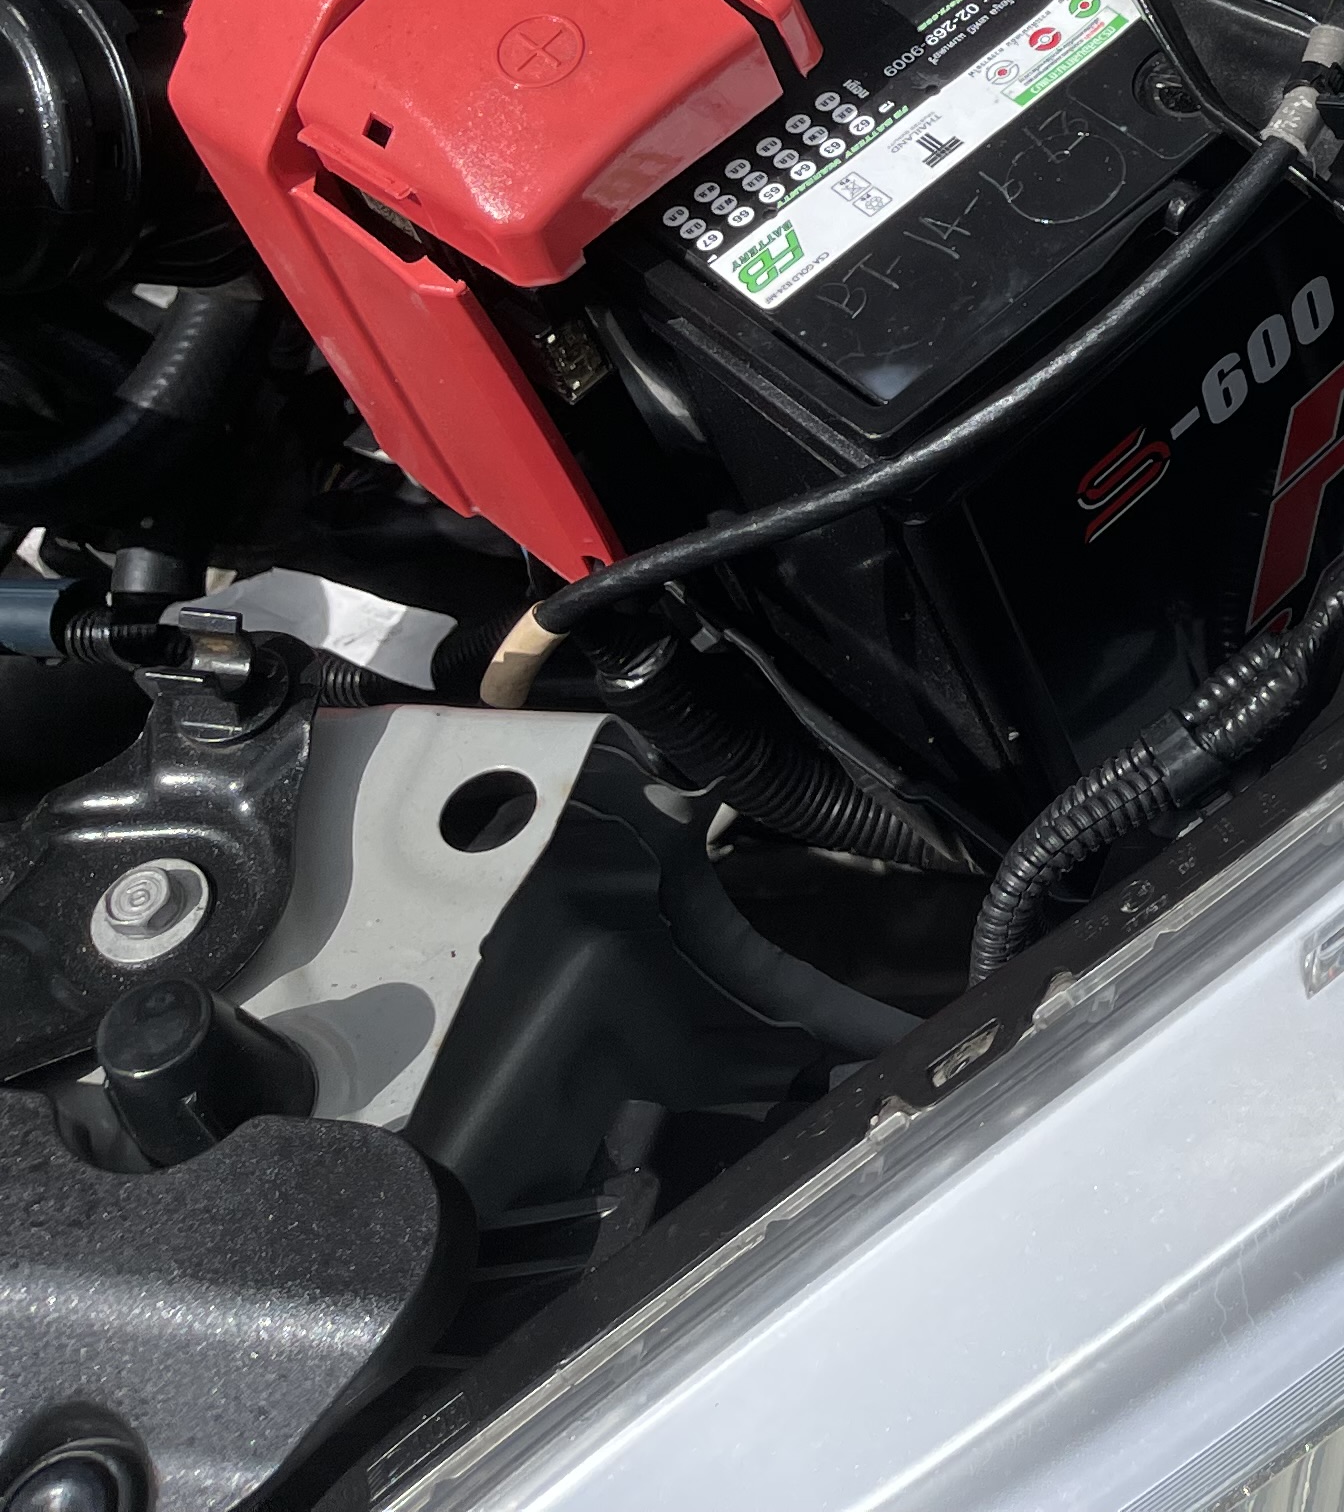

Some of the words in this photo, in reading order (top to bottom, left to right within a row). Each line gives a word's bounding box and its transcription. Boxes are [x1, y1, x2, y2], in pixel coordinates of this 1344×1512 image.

[881, 1, 981, 78] 02-269-9009
[854, 119, 870, 132] 62
[890, 110, 943, 154] THAILAND
[844, 116, 893, 157] BATTERY
[824, 142, 841, 154] 63
[794, 164, 811, 177] 64
[763, 186, 780, 199] 65
[777, 158, 840, 209] WARRANTY
[732, 210, 749, 223] 66
[703, 234, 718, 248] 67
[732, 220, 792, 272] BATTERY
[735, 228, 804, 292] FB
[813, 252, 829, 264] CSA
[792, 264, 814, 282] GOLD
[1077, 275, 1335, 544] S-600
